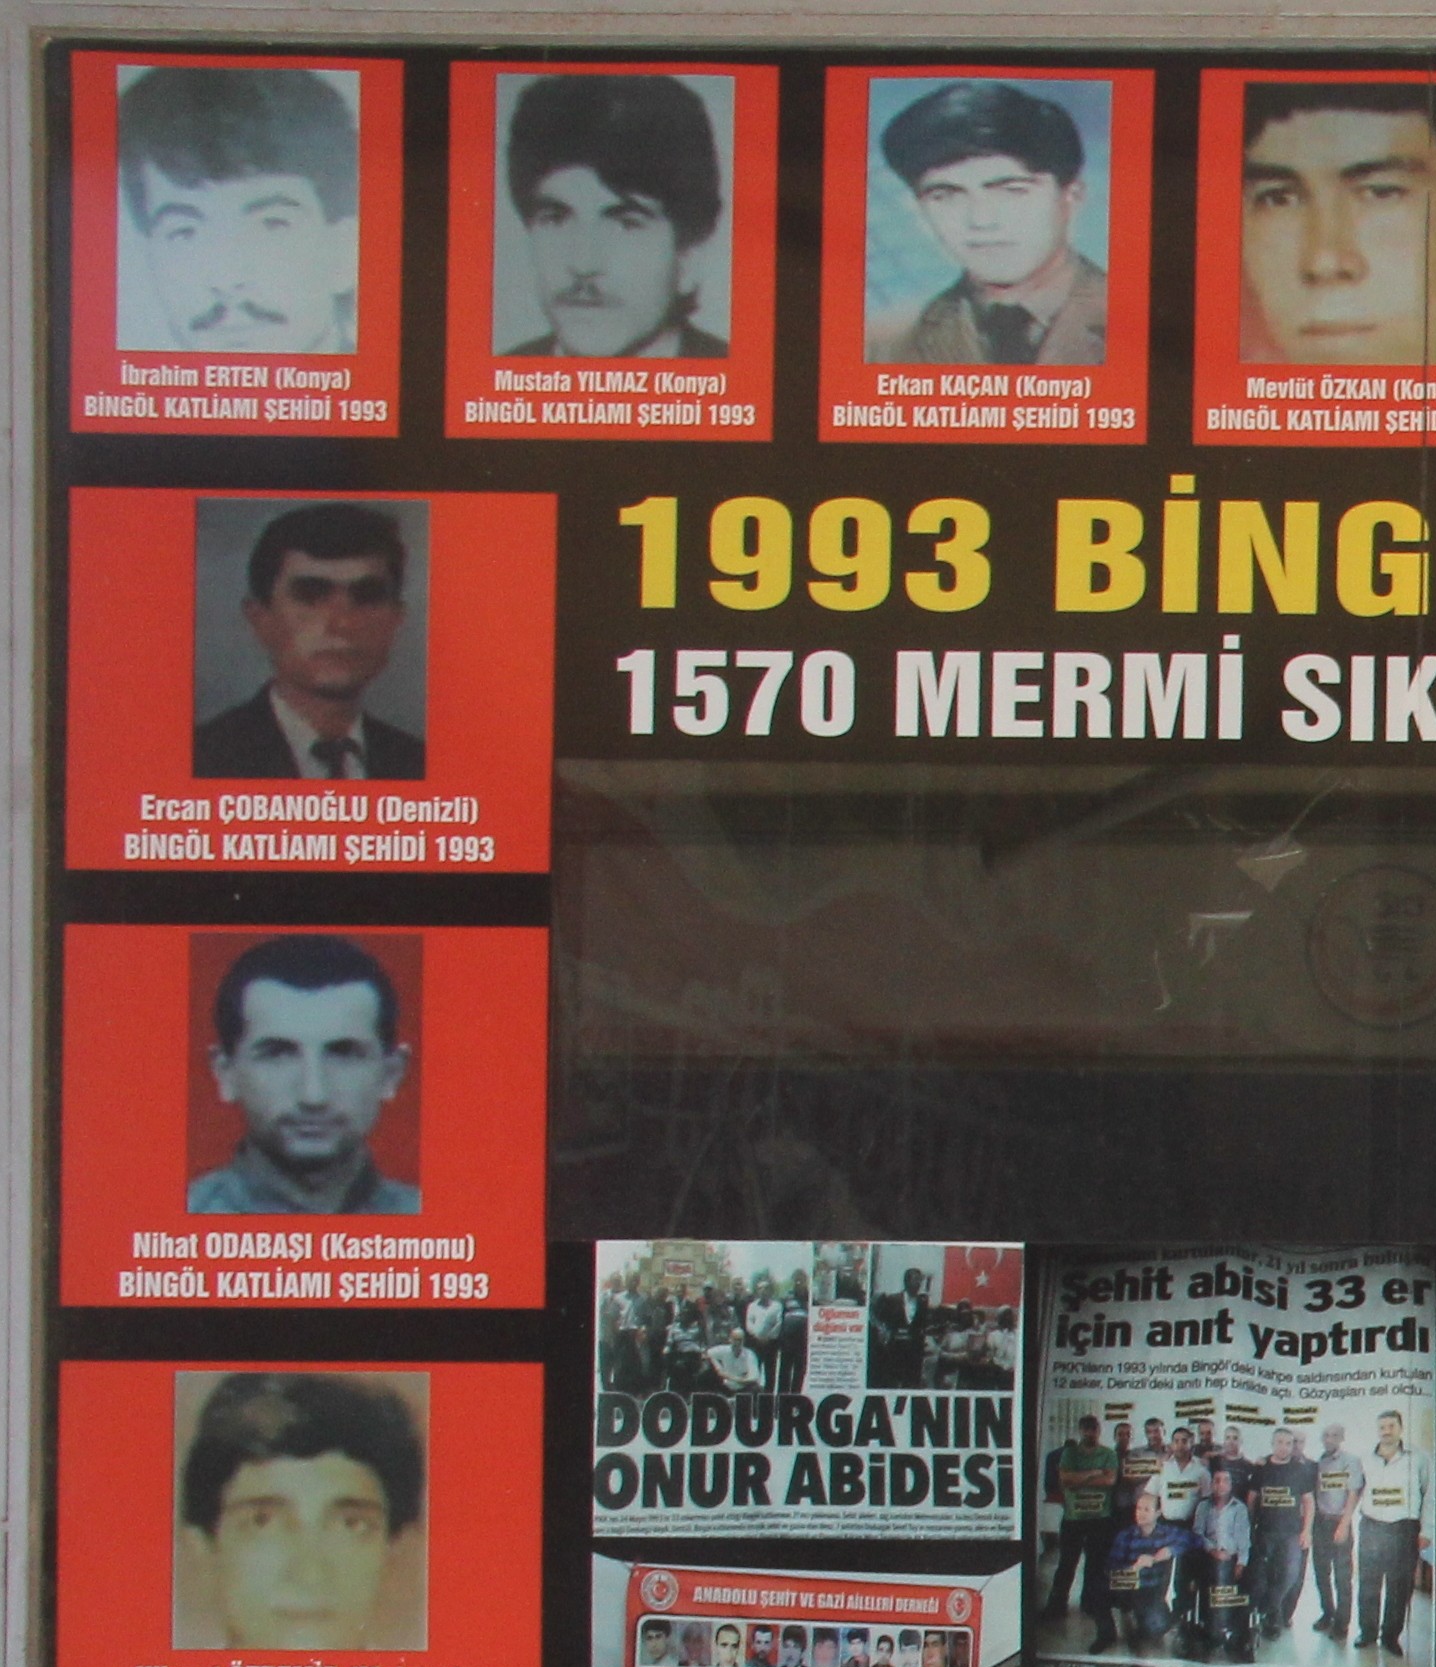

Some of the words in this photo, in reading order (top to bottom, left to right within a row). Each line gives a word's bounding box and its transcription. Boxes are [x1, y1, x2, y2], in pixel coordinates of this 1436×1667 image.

[120, 359, 200, 387] İbrahim
[204, 364, 269, 388] ERTEN
[274, 366, 351, 391] (Konya)
[493, 369, 573, 392] Mustafa
[576, 370, 649, 393] YILMAZ
[654, 371, 727, 396] (Konya)
[876, 373, 935, 396] Erkan
[940, 374, 1010, 399] KAÇAN
[1015, 374, 1092, 400] (Konya)
[1246, 376, 1316, 400] Mevlüt
[1320, 373, 1388, 400] ÖZKAN
[620, 496, 991, 612] 1993
[616, 649, 855, 737] 1570
[895, 634, 1243, 740] MERMİ
[140, 793, 212, 821] Ercan
[218, 789, 369, 825] ÇOBANOĞLU
[375, 795, 479, 825] (Denizli)
[132, 1231, 199, 1259] Nihat
[204, 1231, 313, 1263] ODABAŞI
[320, 1232, 476, 1262] (Kastamonu)
[1060, 1266, 1174, 1313] Şehit
[1187, 1261, 1290, 1311] abisi
[1303, 1274, 1367, 1313] 33
[1381, 1276, 1433, 1307] er
[1055, 1313, 1133, 1357] için
[1145, 1307, 1235, 1348] anıt
[1248, 1316, 1431, 1366] yaptırdı
[596, 1391, 1014, 1448] DODURGA'NIN
[594, 1452, 772, 1510] ONUR
